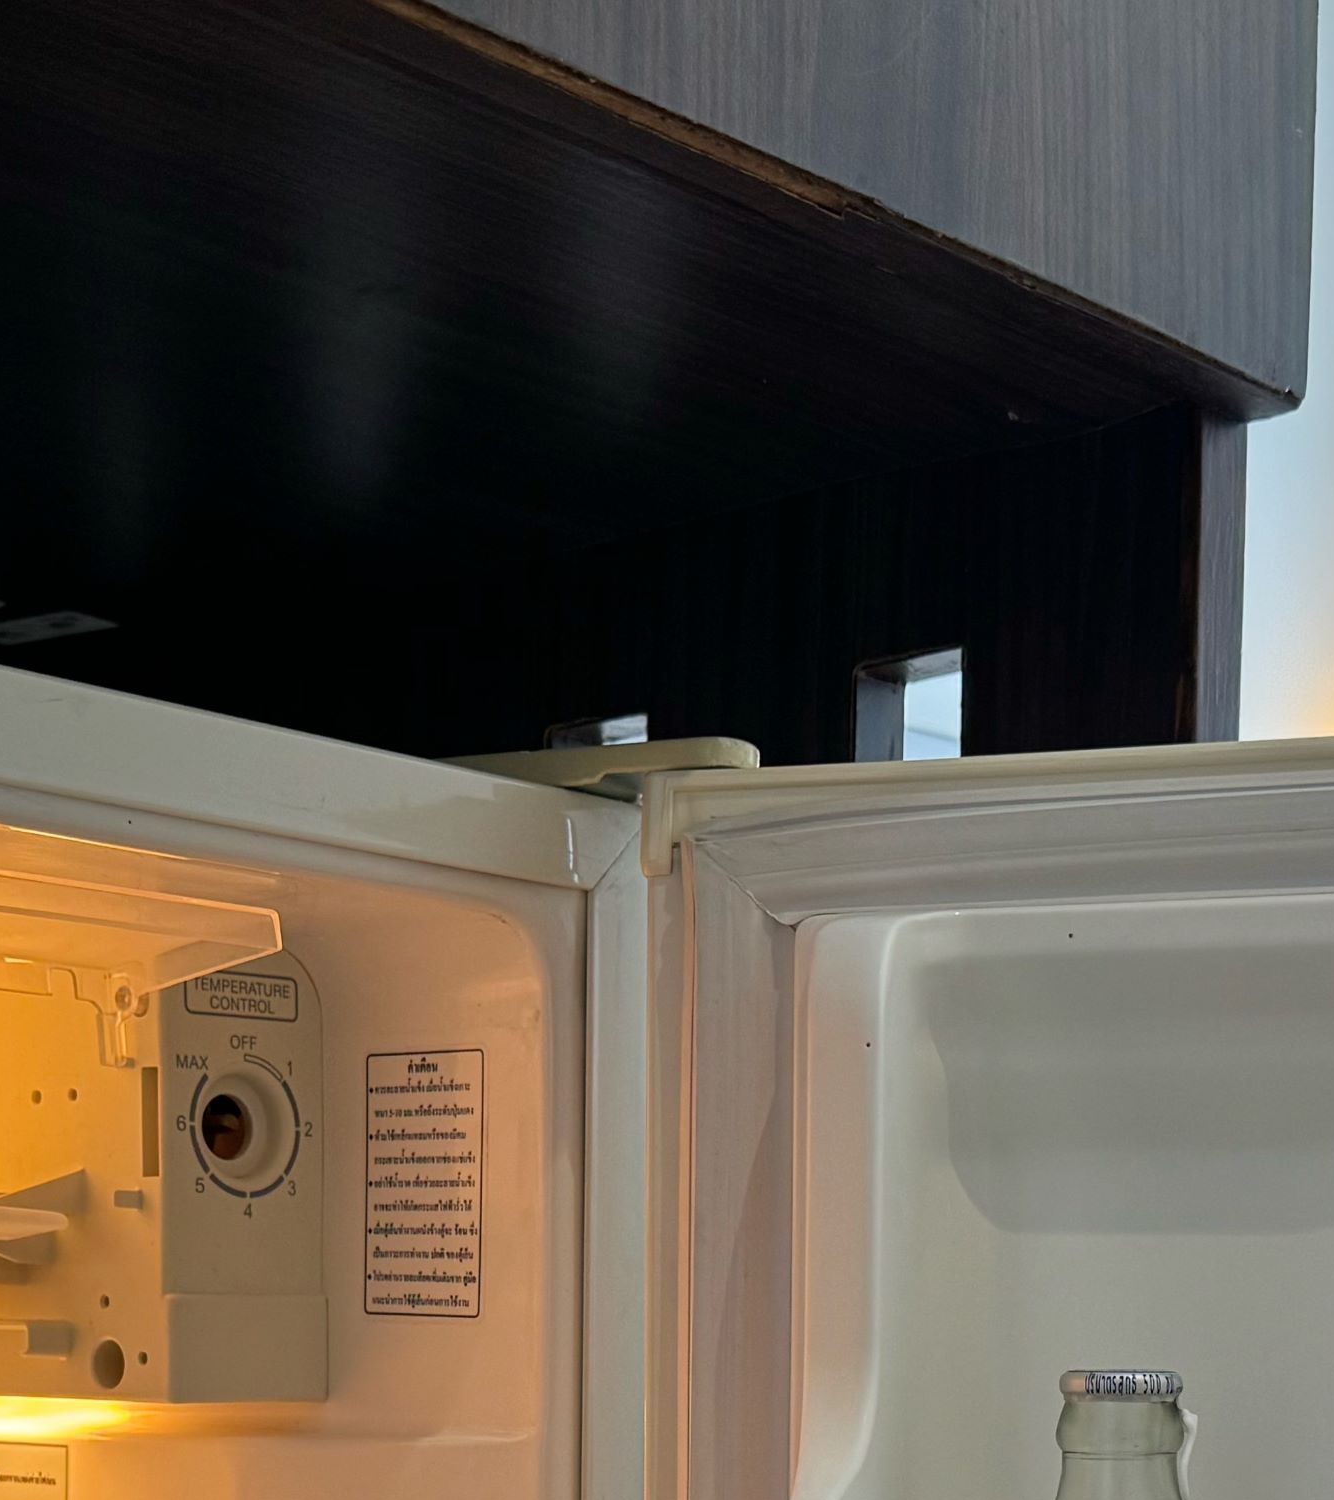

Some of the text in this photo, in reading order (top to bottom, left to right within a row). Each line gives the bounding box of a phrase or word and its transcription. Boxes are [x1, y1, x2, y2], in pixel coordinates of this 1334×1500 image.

[194, 977, 291, 999] TEMPERATURE
[210, 996, 275, 1014] CONTROL
[230, 1034, 257, 1050] OFF
[175, 1054, 209, 1070] MAX
[287, 1061, 293, 1075] 1
[176, 1115, 187, 1131] 6
[304, 1121, 313, 1137] 2
[195, 1178, 205, 1193] 5
[287, 1180, 297, 1195] 3
[243, 1203, 253, 1218] 4
[1143, 1373, 1161, 1395] 500
